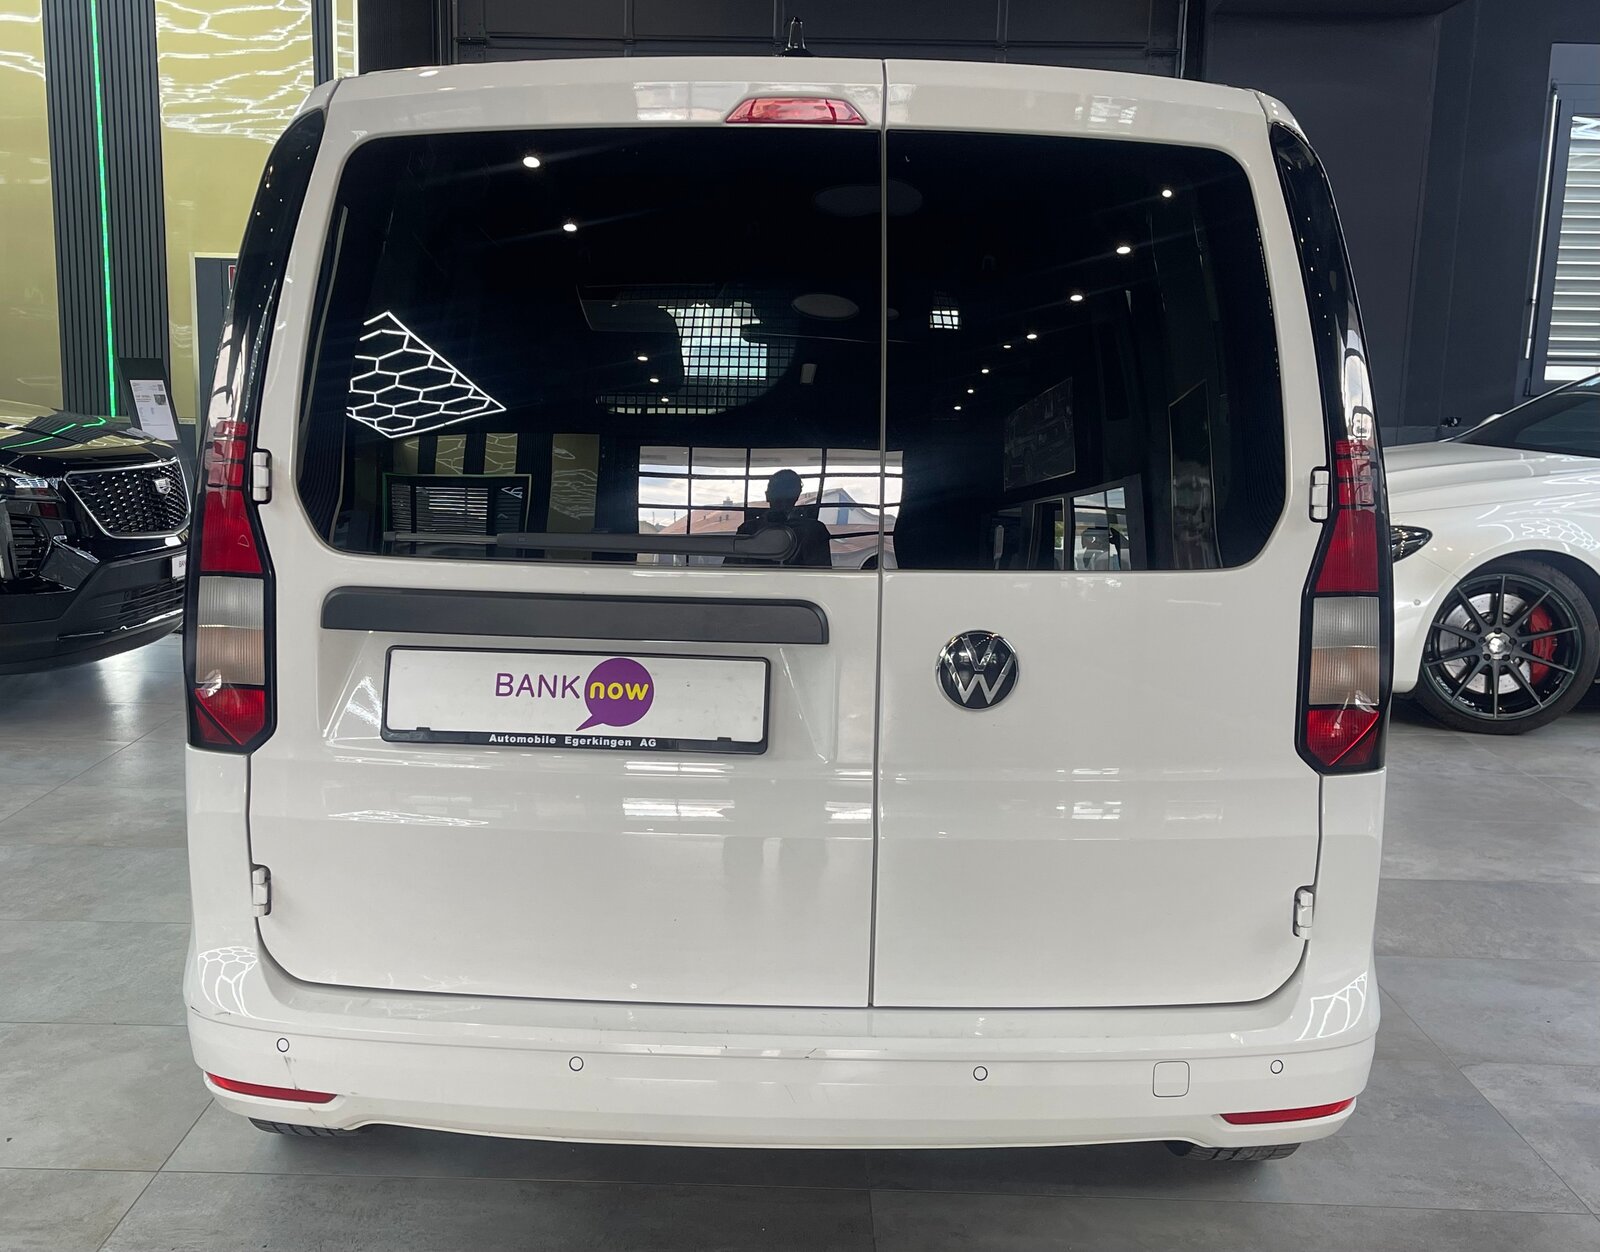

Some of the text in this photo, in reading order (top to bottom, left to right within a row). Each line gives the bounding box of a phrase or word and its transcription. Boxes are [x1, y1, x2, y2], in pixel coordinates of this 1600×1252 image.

[943, 634, 1015, 705] VW
[495, 672, 649, 701] BANK now
[488, 733, 657, 748] Automobile Egerkingen AG
